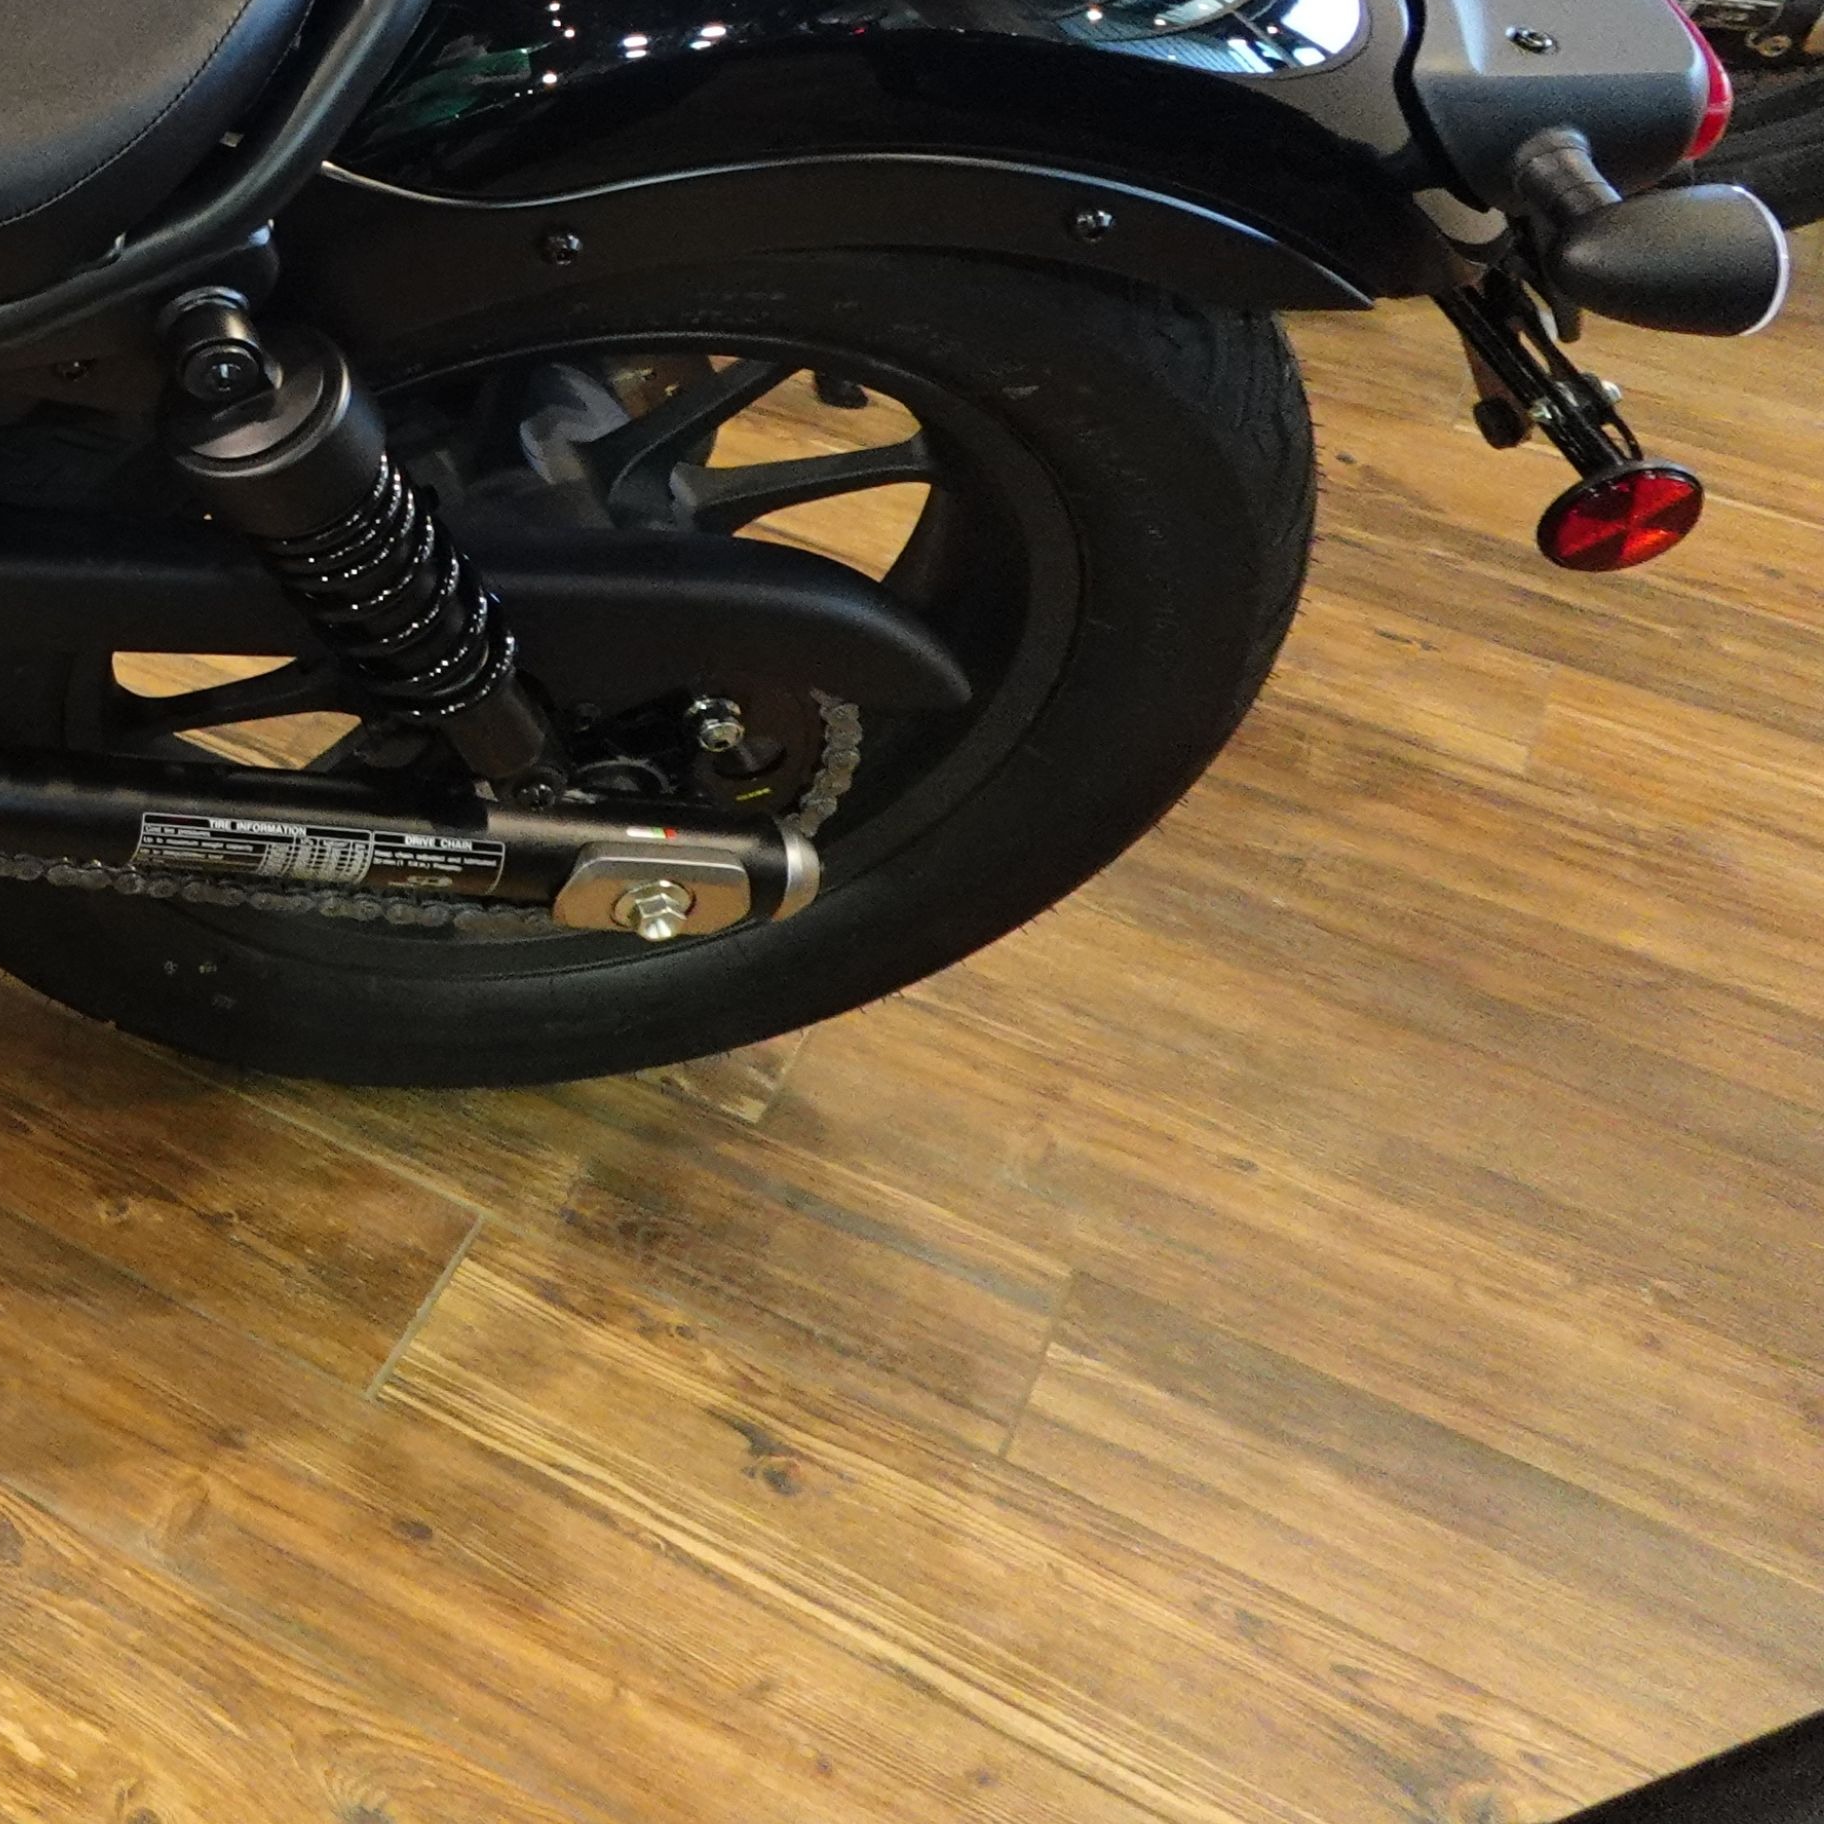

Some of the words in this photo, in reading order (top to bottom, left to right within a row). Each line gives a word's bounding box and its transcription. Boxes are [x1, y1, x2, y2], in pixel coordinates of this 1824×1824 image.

[209, 819, 231, 830] TIRE
[236, 820, 308, 838] INFORMATION
[404, 835, 435, 848] DRIVE
[440, 838, 473, 851] CHAIN
